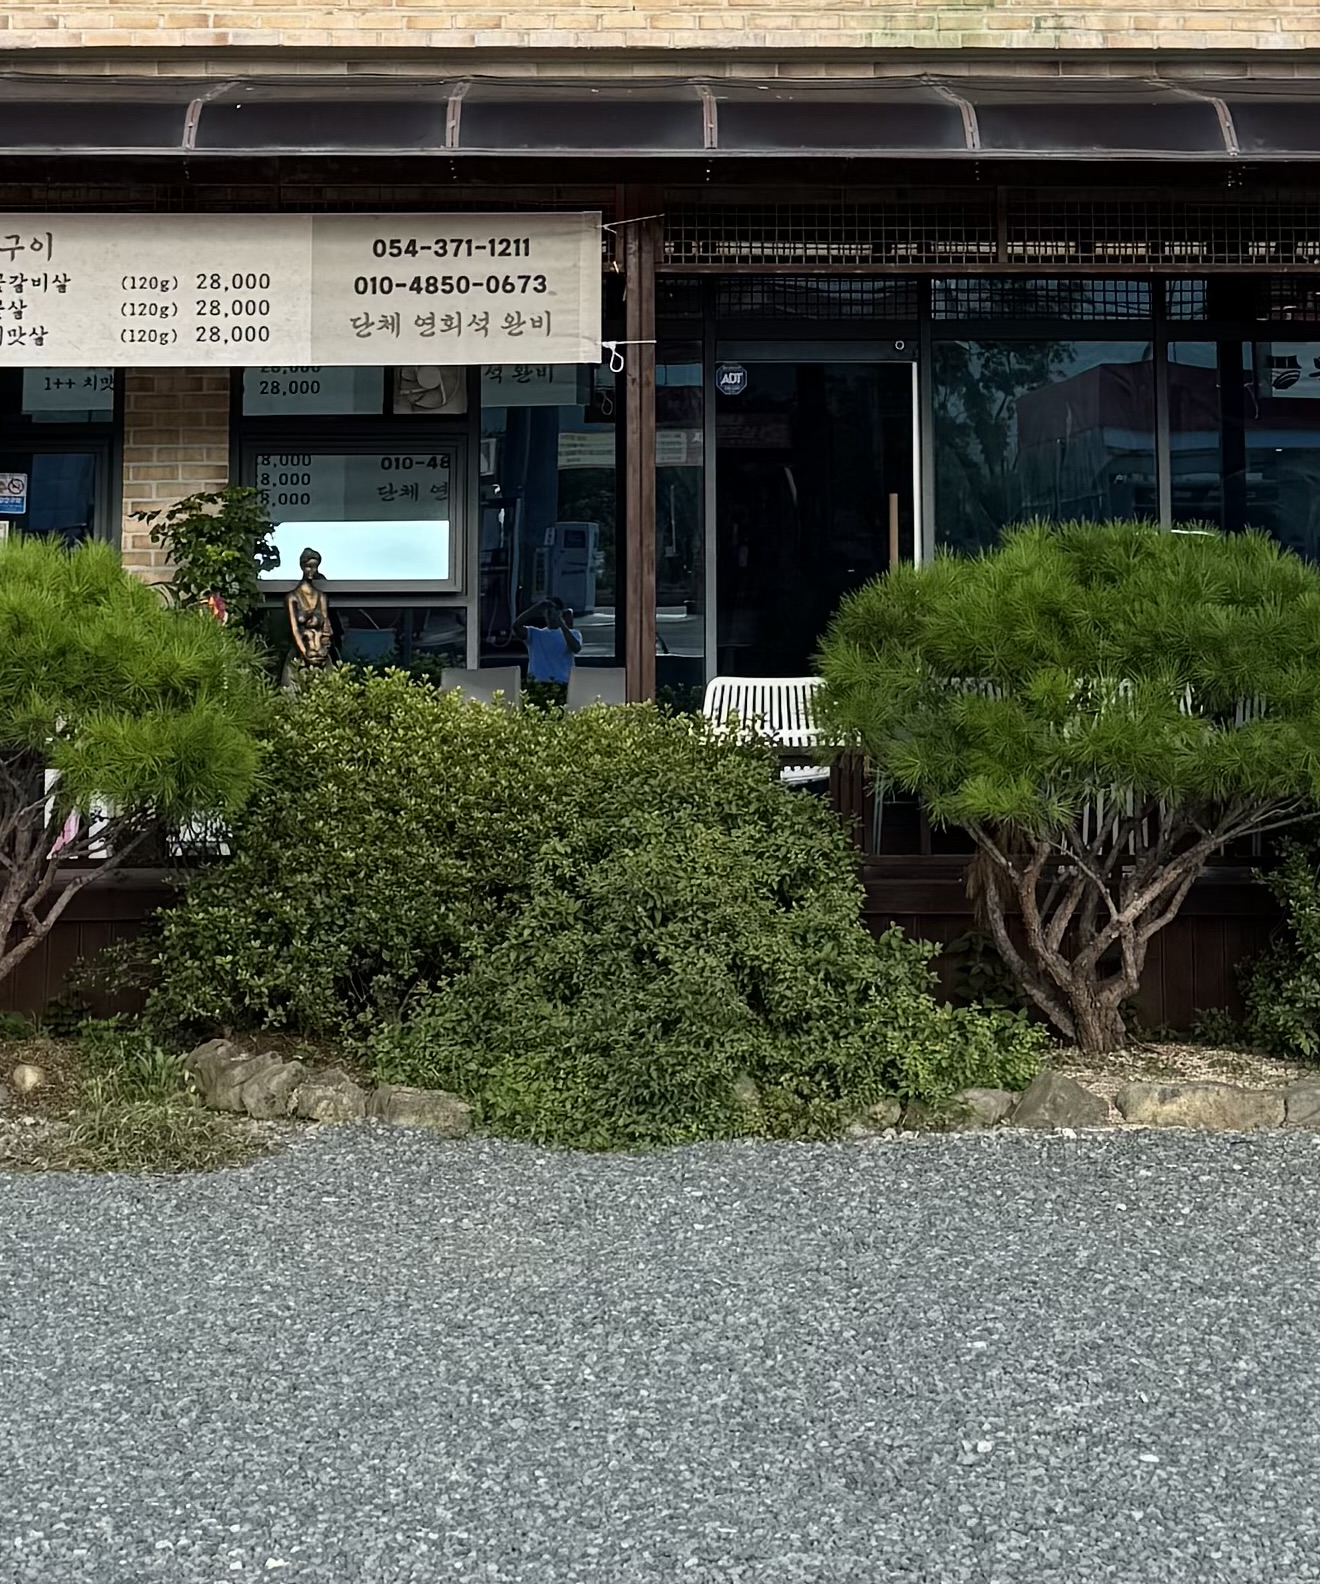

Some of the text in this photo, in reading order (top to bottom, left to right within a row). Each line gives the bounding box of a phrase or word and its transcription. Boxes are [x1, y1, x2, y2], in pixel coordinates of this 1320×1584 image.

[372, 238, 530, 257] 054-371-1211
[121, 276, 178, 292] (120g)
[196, 273, 270, 293] 28,000
[354, 275, 547, 295] 010-4850-0673
[120, 302, 178, 317] (120g)
[195, 299, 270, 318] 28,000
[350, 310, 551, 338] 단체 연회석 완비
[119, 328, 178, 344] (120g)
[195, 326, 270, 344] 28,000
[44, 377, 76, 390] 1++
[260, 381, 321, 396] 28,000
[257, 455, 312, 467] 8,000
[257, 473, 311, 487] 8,000
[257, 491, 311, 507] 8,000
[377, 483, 419, 502] 단체
